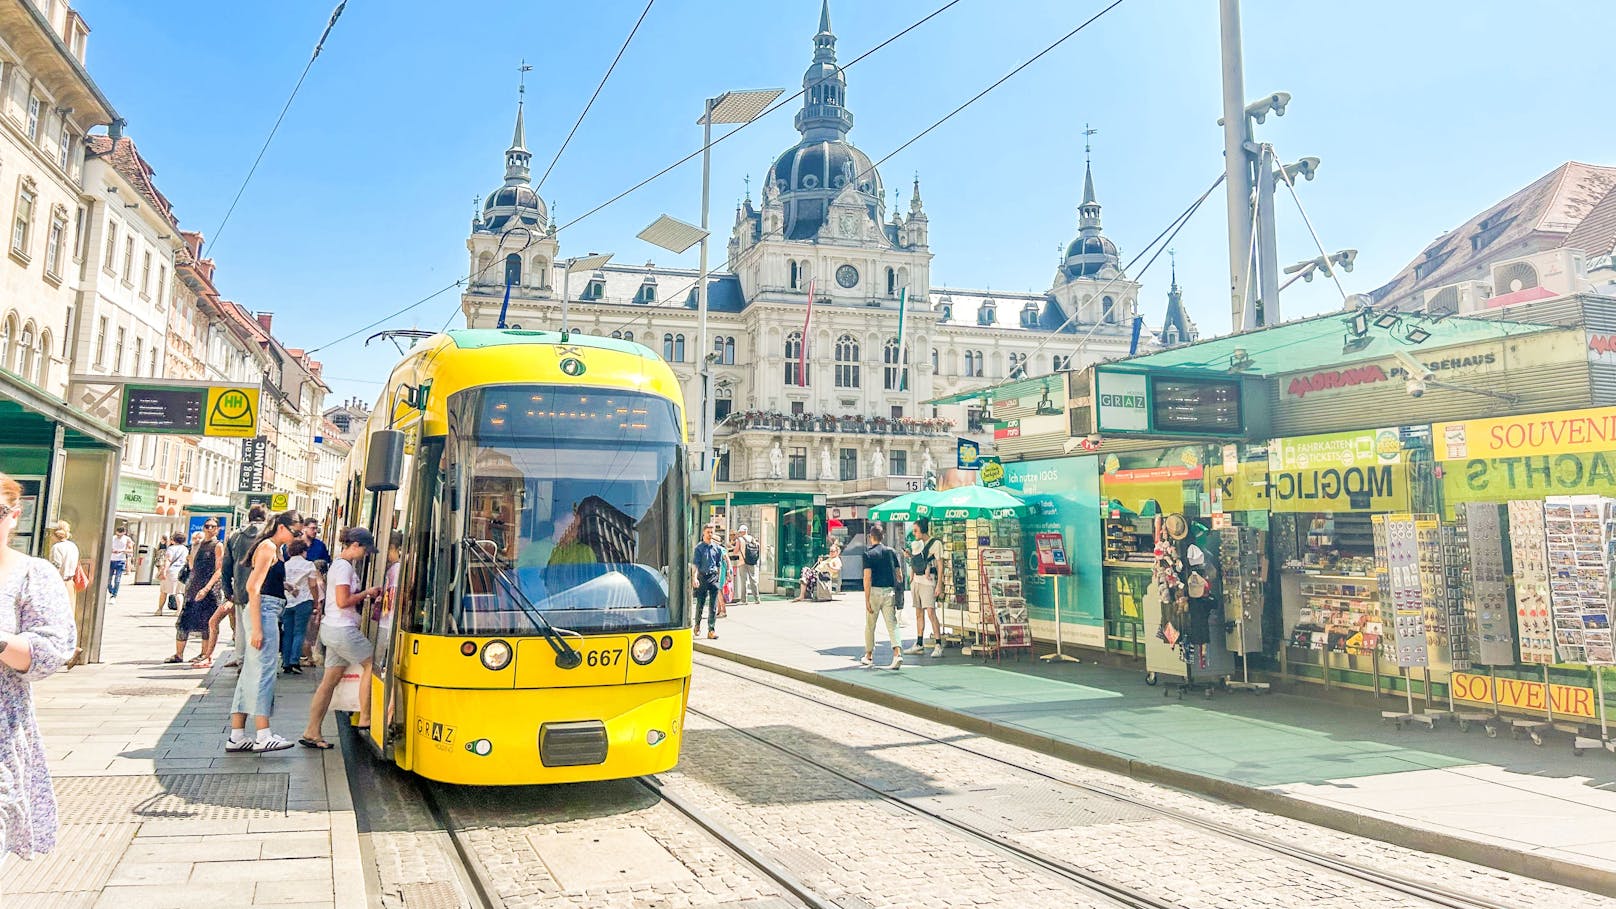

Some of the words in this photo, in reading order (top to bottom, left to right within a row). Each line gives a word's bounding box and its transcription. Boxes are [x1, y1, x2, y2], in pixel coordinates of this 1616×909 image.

[1288, 365, 1388, 398] MORAWA
[1101, 395, 1145, 408] GRAZ
[1297, 439, 1353, 452] FAHRKARTEN
[1308, 451, 1342, 463] TICKETS
[252, 442, 265, 491] HUMANIC
[240, 466, 252, 488] Frag
[906, 481, 918, 491] 15
[890, 512, 910, 521] LOTTO
[944, 508, 969, 518] LOTTO
[587, 649, 623, 666] 667
[1454, 673, 1592, 716] SOUVENIR
[417, 719, 454, 743] GRAZ
